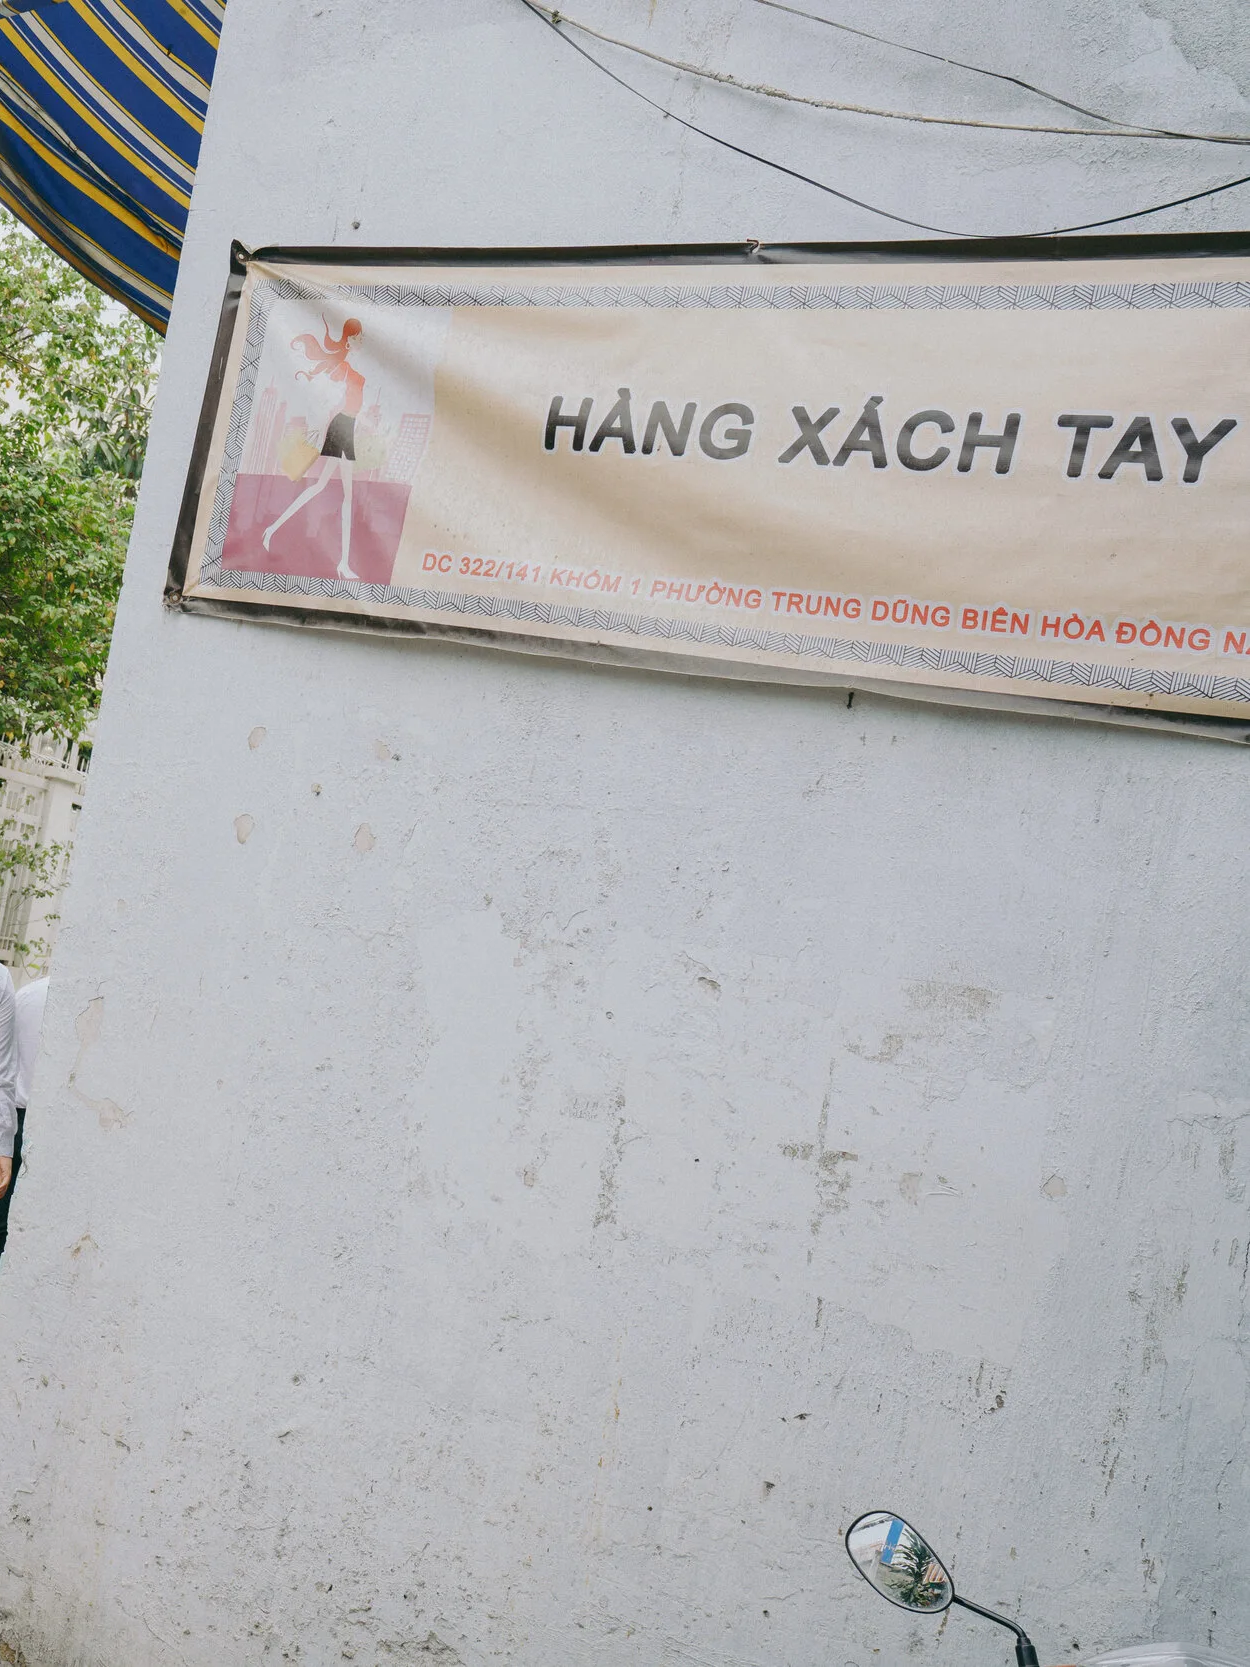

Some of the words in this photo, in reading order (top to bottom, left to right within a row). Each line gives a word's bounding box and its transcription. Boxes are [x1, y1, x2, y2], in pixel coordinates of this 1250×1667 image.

[544, 387, 755, 461] HÀNG
[777, 395, 1022, 474] XÁCH
[1057, 414, 1237, 483] TAY
[422, 552, 453, 574] DC
[458, 556, 542, 582] 322/141
[549, 567, 621, 594] KHÓM
[631, 577, 642, 596] 1
[649, 580, 763, 610] PHƯỜNG
[771, 591, 862, 619] TRUNG
[871, 599, 951, 628] DŨNG
[961, 606, 1030, 635] BIÊN
[1040, 613, 1107, 642] HÒA
[1223, 630, 1250, 656] N
